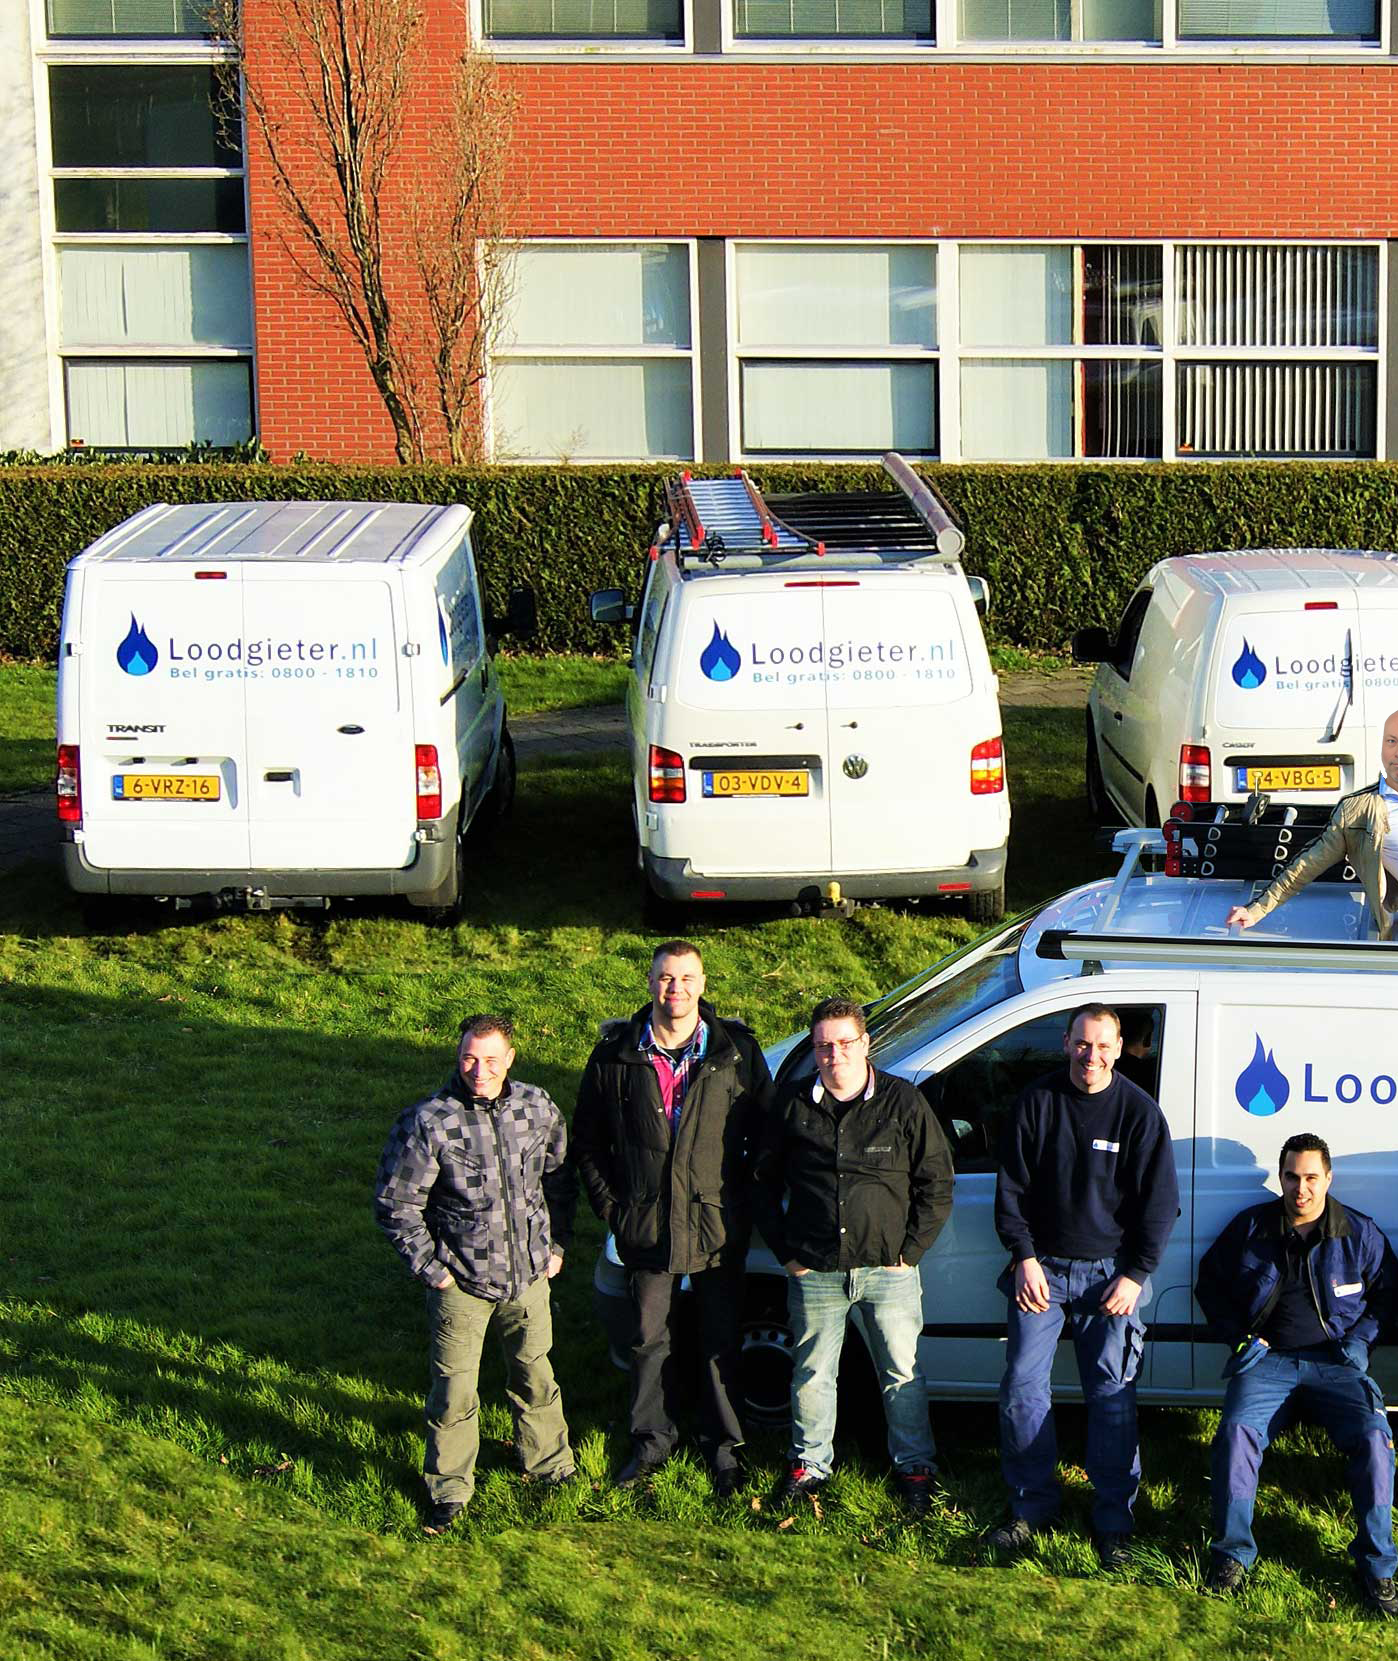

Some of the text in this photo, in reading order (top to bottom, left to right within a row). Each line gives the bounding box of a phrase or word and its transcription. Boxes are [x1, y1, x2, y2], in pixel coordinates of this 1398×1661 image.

[169, 637, 377, 666] Loodgieter.nl
[752, 639, 954, 669] Loodgieter.nl
[170, 668, 198, 679] Bel
[204, 667, 265, 681] gratis:
[271, 667, 316, 679] 0800
[336, 667, 378, 679] 1810
[752, 672, 780, 683] Bel
[787, 671, 846, 685] gratis:
[853, 670, 896, 681] 0800
[915, 669, 956, 680] 1810
[106, 725, 166, 733] TRANSIT
[133, 778, 210, 794] 6-VRZ-16
[719, 775, 801, 791] 03-VDV-4
